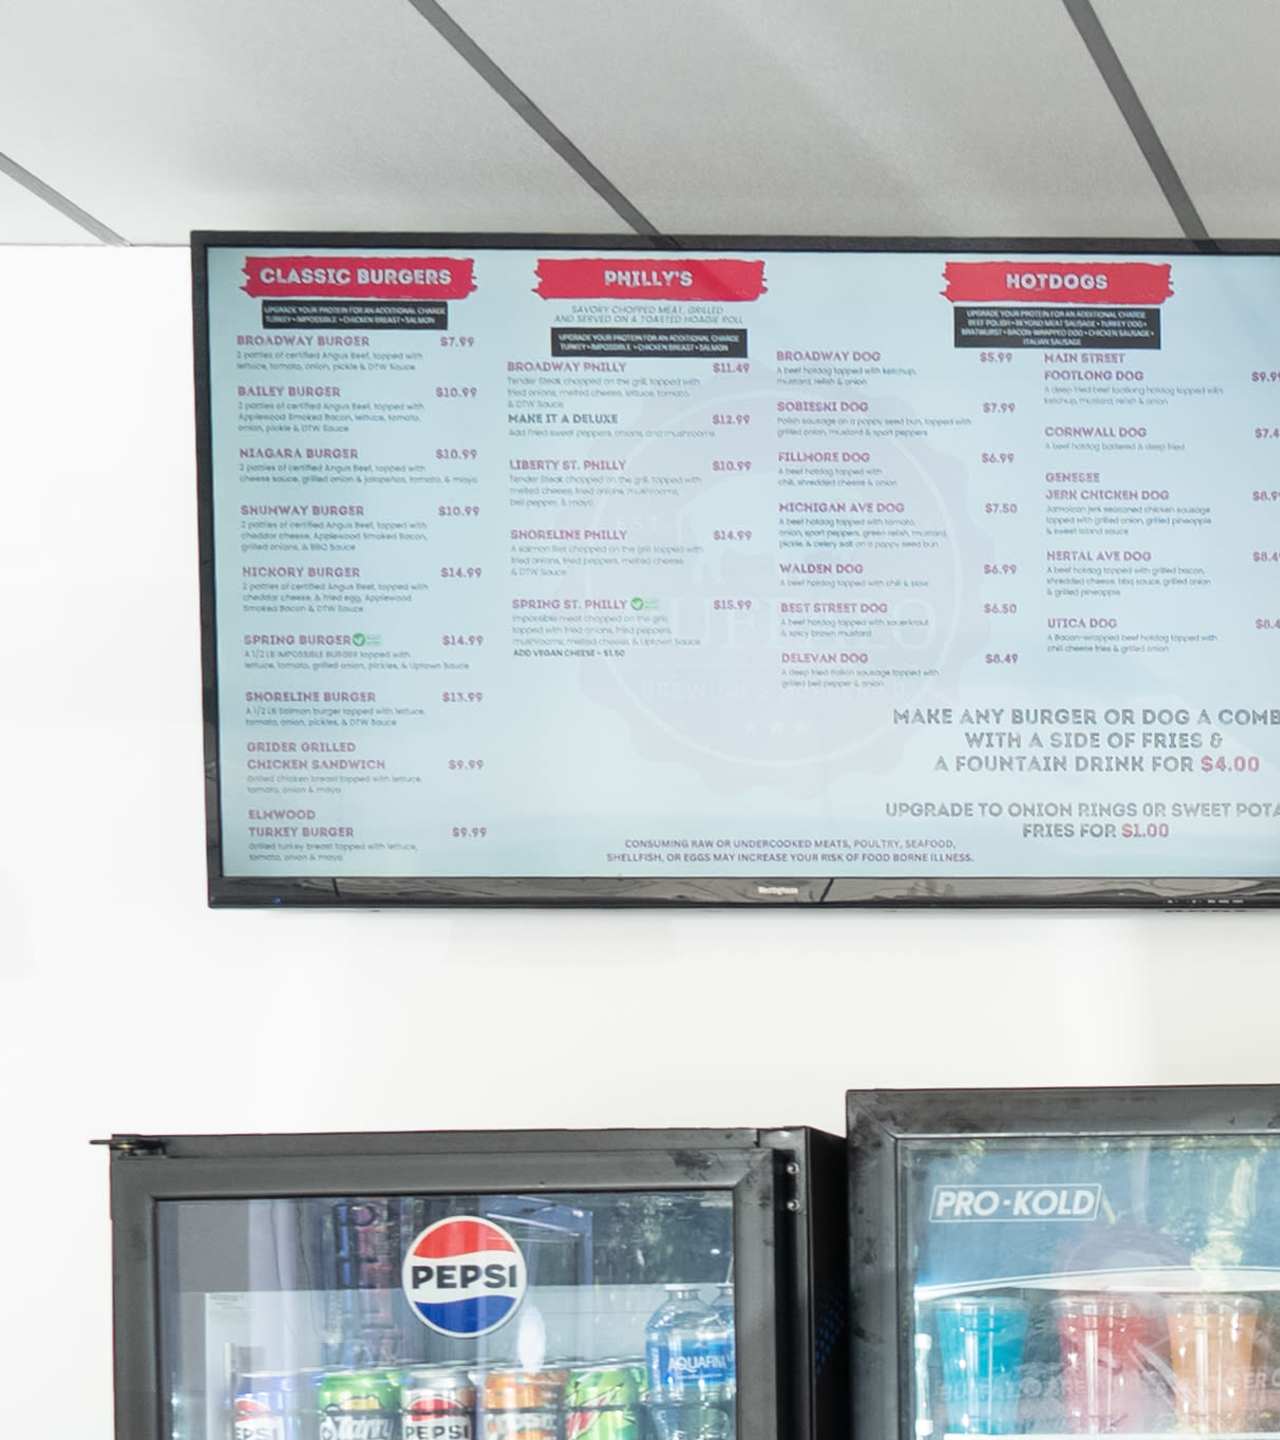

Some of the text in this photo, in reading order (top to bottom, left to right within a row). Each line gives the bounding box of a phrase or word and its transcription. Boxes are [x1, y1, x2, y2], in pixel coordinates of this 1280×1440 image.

[260, 269, 451, 287] CLASSIC BURGERS
[605, 271, 692, 286] PHILLY'S
[1007, 272, 1109, 289] HOTDOGS
[237, 335, 474, 348] BROADWAY BURGER $7.99
[507, 361, 750, 373] BROADWAY PHILLY $11.49
[238, 386, 477, 397] BAILEY BURGER $10.99
[508, 414, 750, 425] MAKE IT A DELUXE $12.99
[242, 567, 481, 578] HICKORY BURGER $14.99
[894, 709, 952, 724] MAKE
[961, 709, 1004, 724] ANY
[1012, 709, 1096, 725] BURGER
[1104, 709, 1134, 725] OR
[1142, 709, 1189, 725] DOG
[1198, 709, 1211, 724] A
[965, 732, 1223, 748] WITH A SIDE OF FRIES &
[247, 759, 483, 770] CHICKEN SANDWICH $9.99
[936, 755, 1259, 772] A FOUNTAIN DRINK FOR $4.00
[886, 803, 973, 817] UPGRADE
[978, 803, 1003, 817] TO
[1008, 803, 1072, 817] ONION
[1078, 803, 1137, 817] RINGS
[1143, 803, 1165, 816] OR
[1172, 803, 1231, 817] SWEET
[1023, 823, 1168, 838] FRIES FOR $1.00
[935, 1190, 1097, 1216] PRO-KOLD
[411, 1264, 518, 1290] PEPSI
